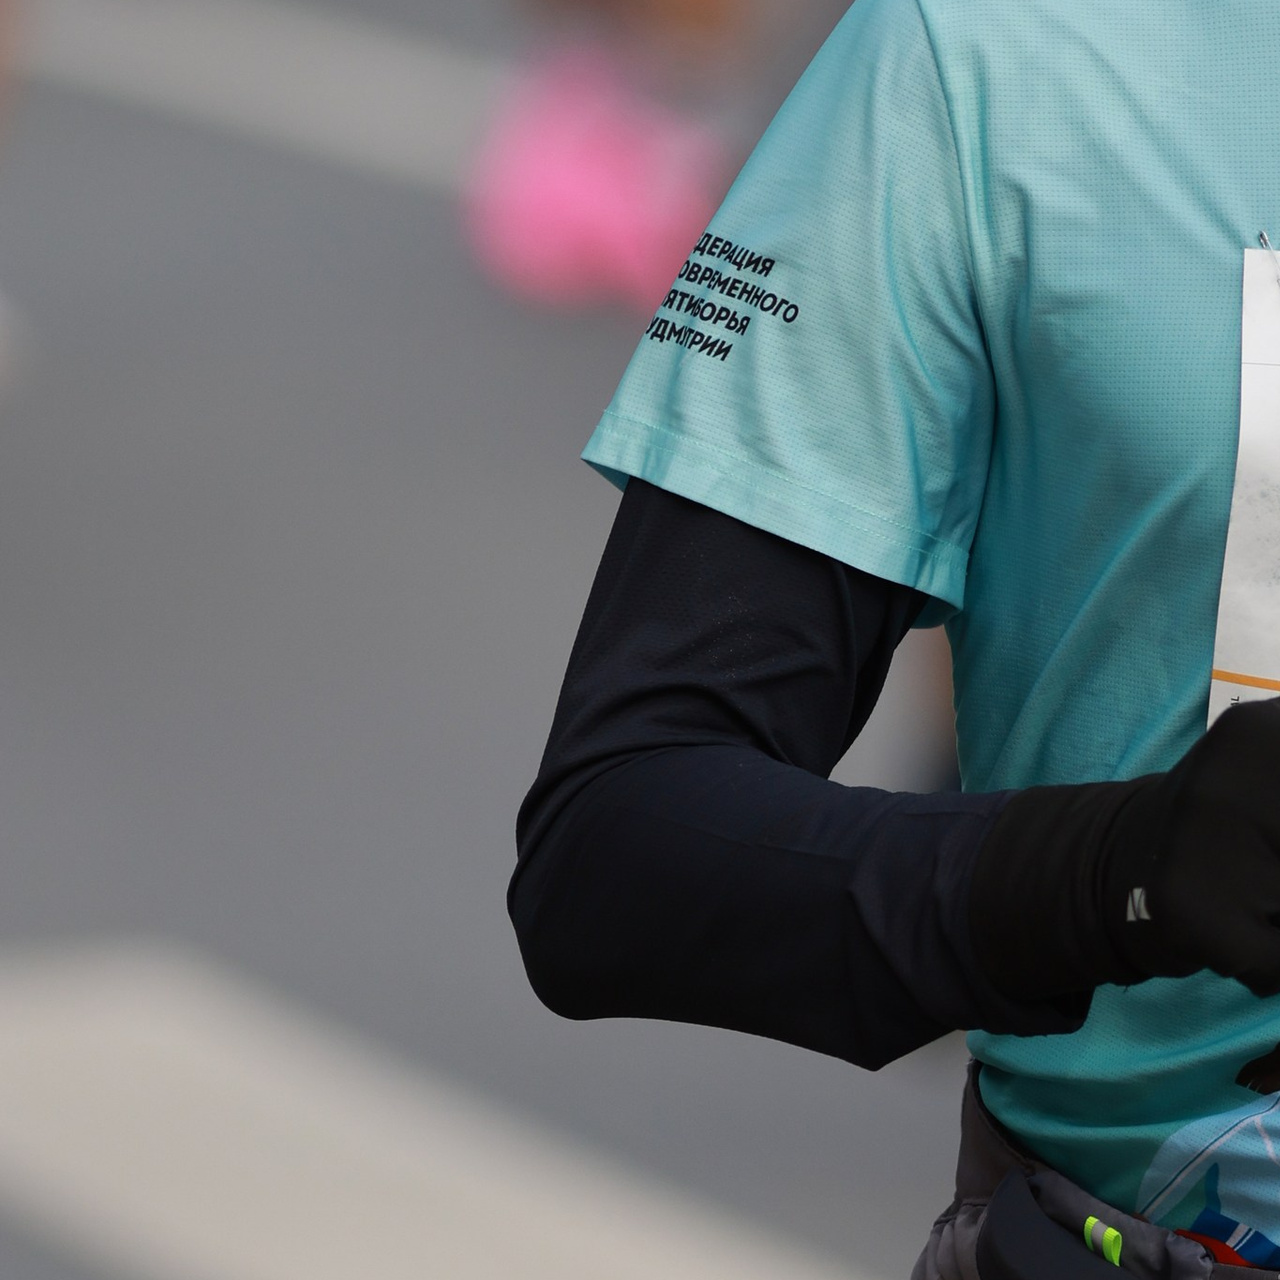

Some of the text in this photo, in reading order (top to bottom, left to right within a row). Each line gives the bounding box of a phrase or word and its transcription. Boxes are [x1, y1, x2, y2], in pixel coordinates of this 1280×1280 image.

[693, 232, 776, 278] ДЕРАЦИЯ
[661, 288, 751, 336] ЯТИБОРЬЯ
[677, 259, 799, 324] ОВРЕМЕННОГО
